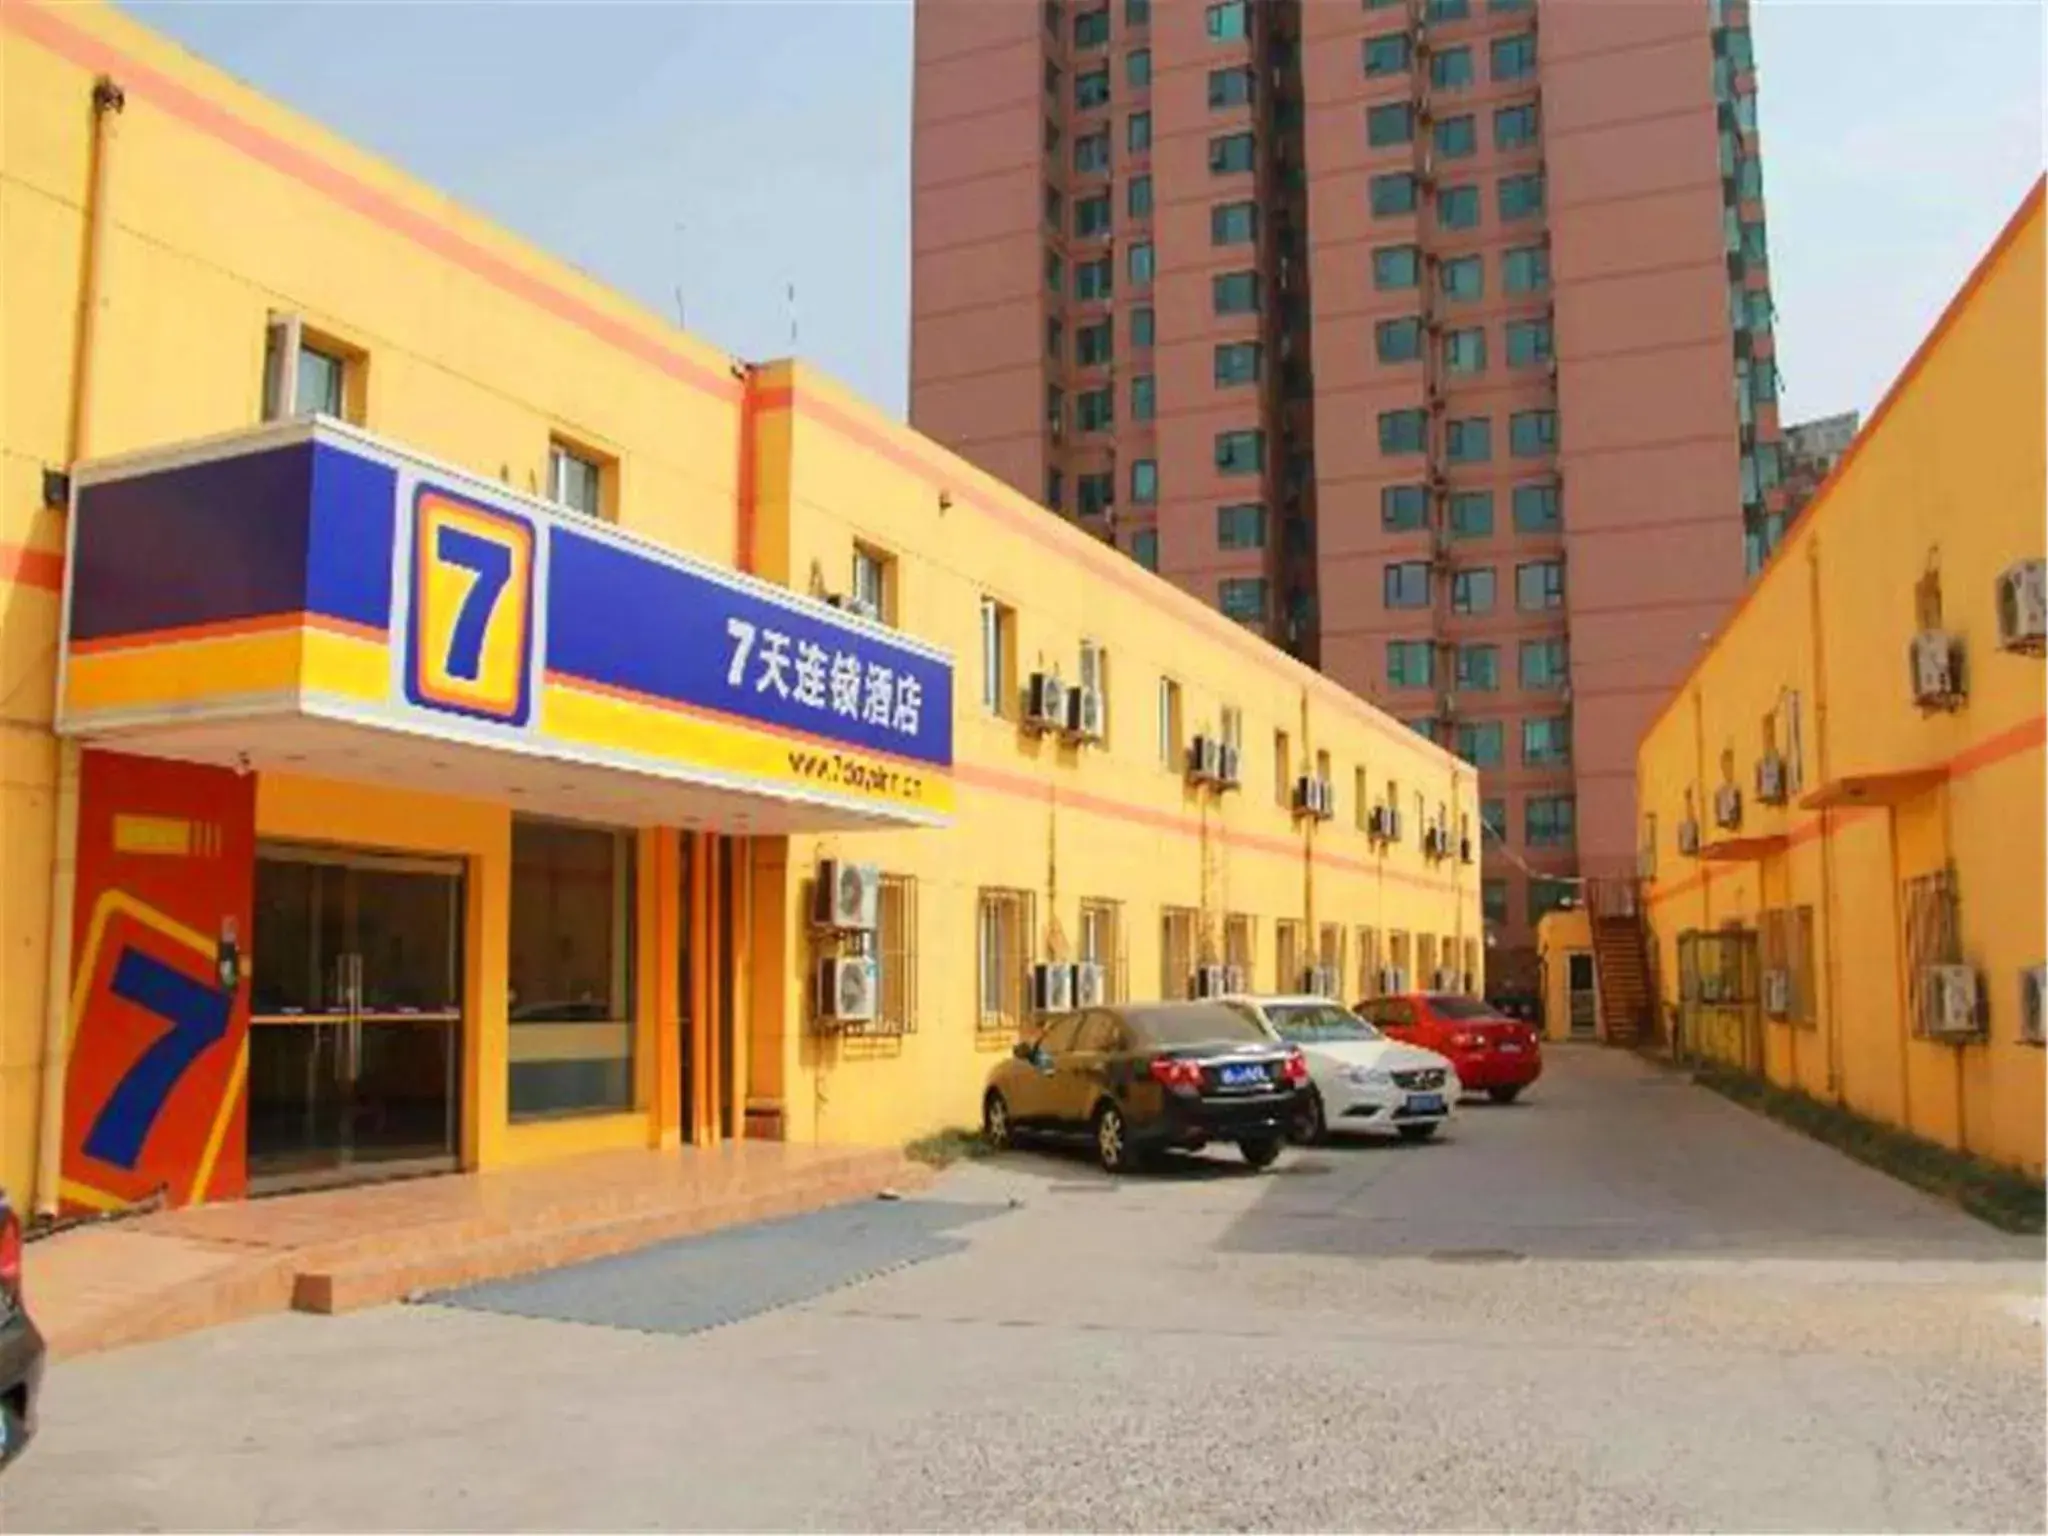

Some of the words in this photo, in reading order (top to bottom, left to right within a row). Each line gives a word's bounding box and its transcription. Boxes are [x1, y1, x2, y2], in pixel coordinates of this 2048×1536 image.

[437, 523, 512, 681] 7
[726, 617, 923, 737] 7天连锁酒店
[81, 944, 233, 1171] 7
